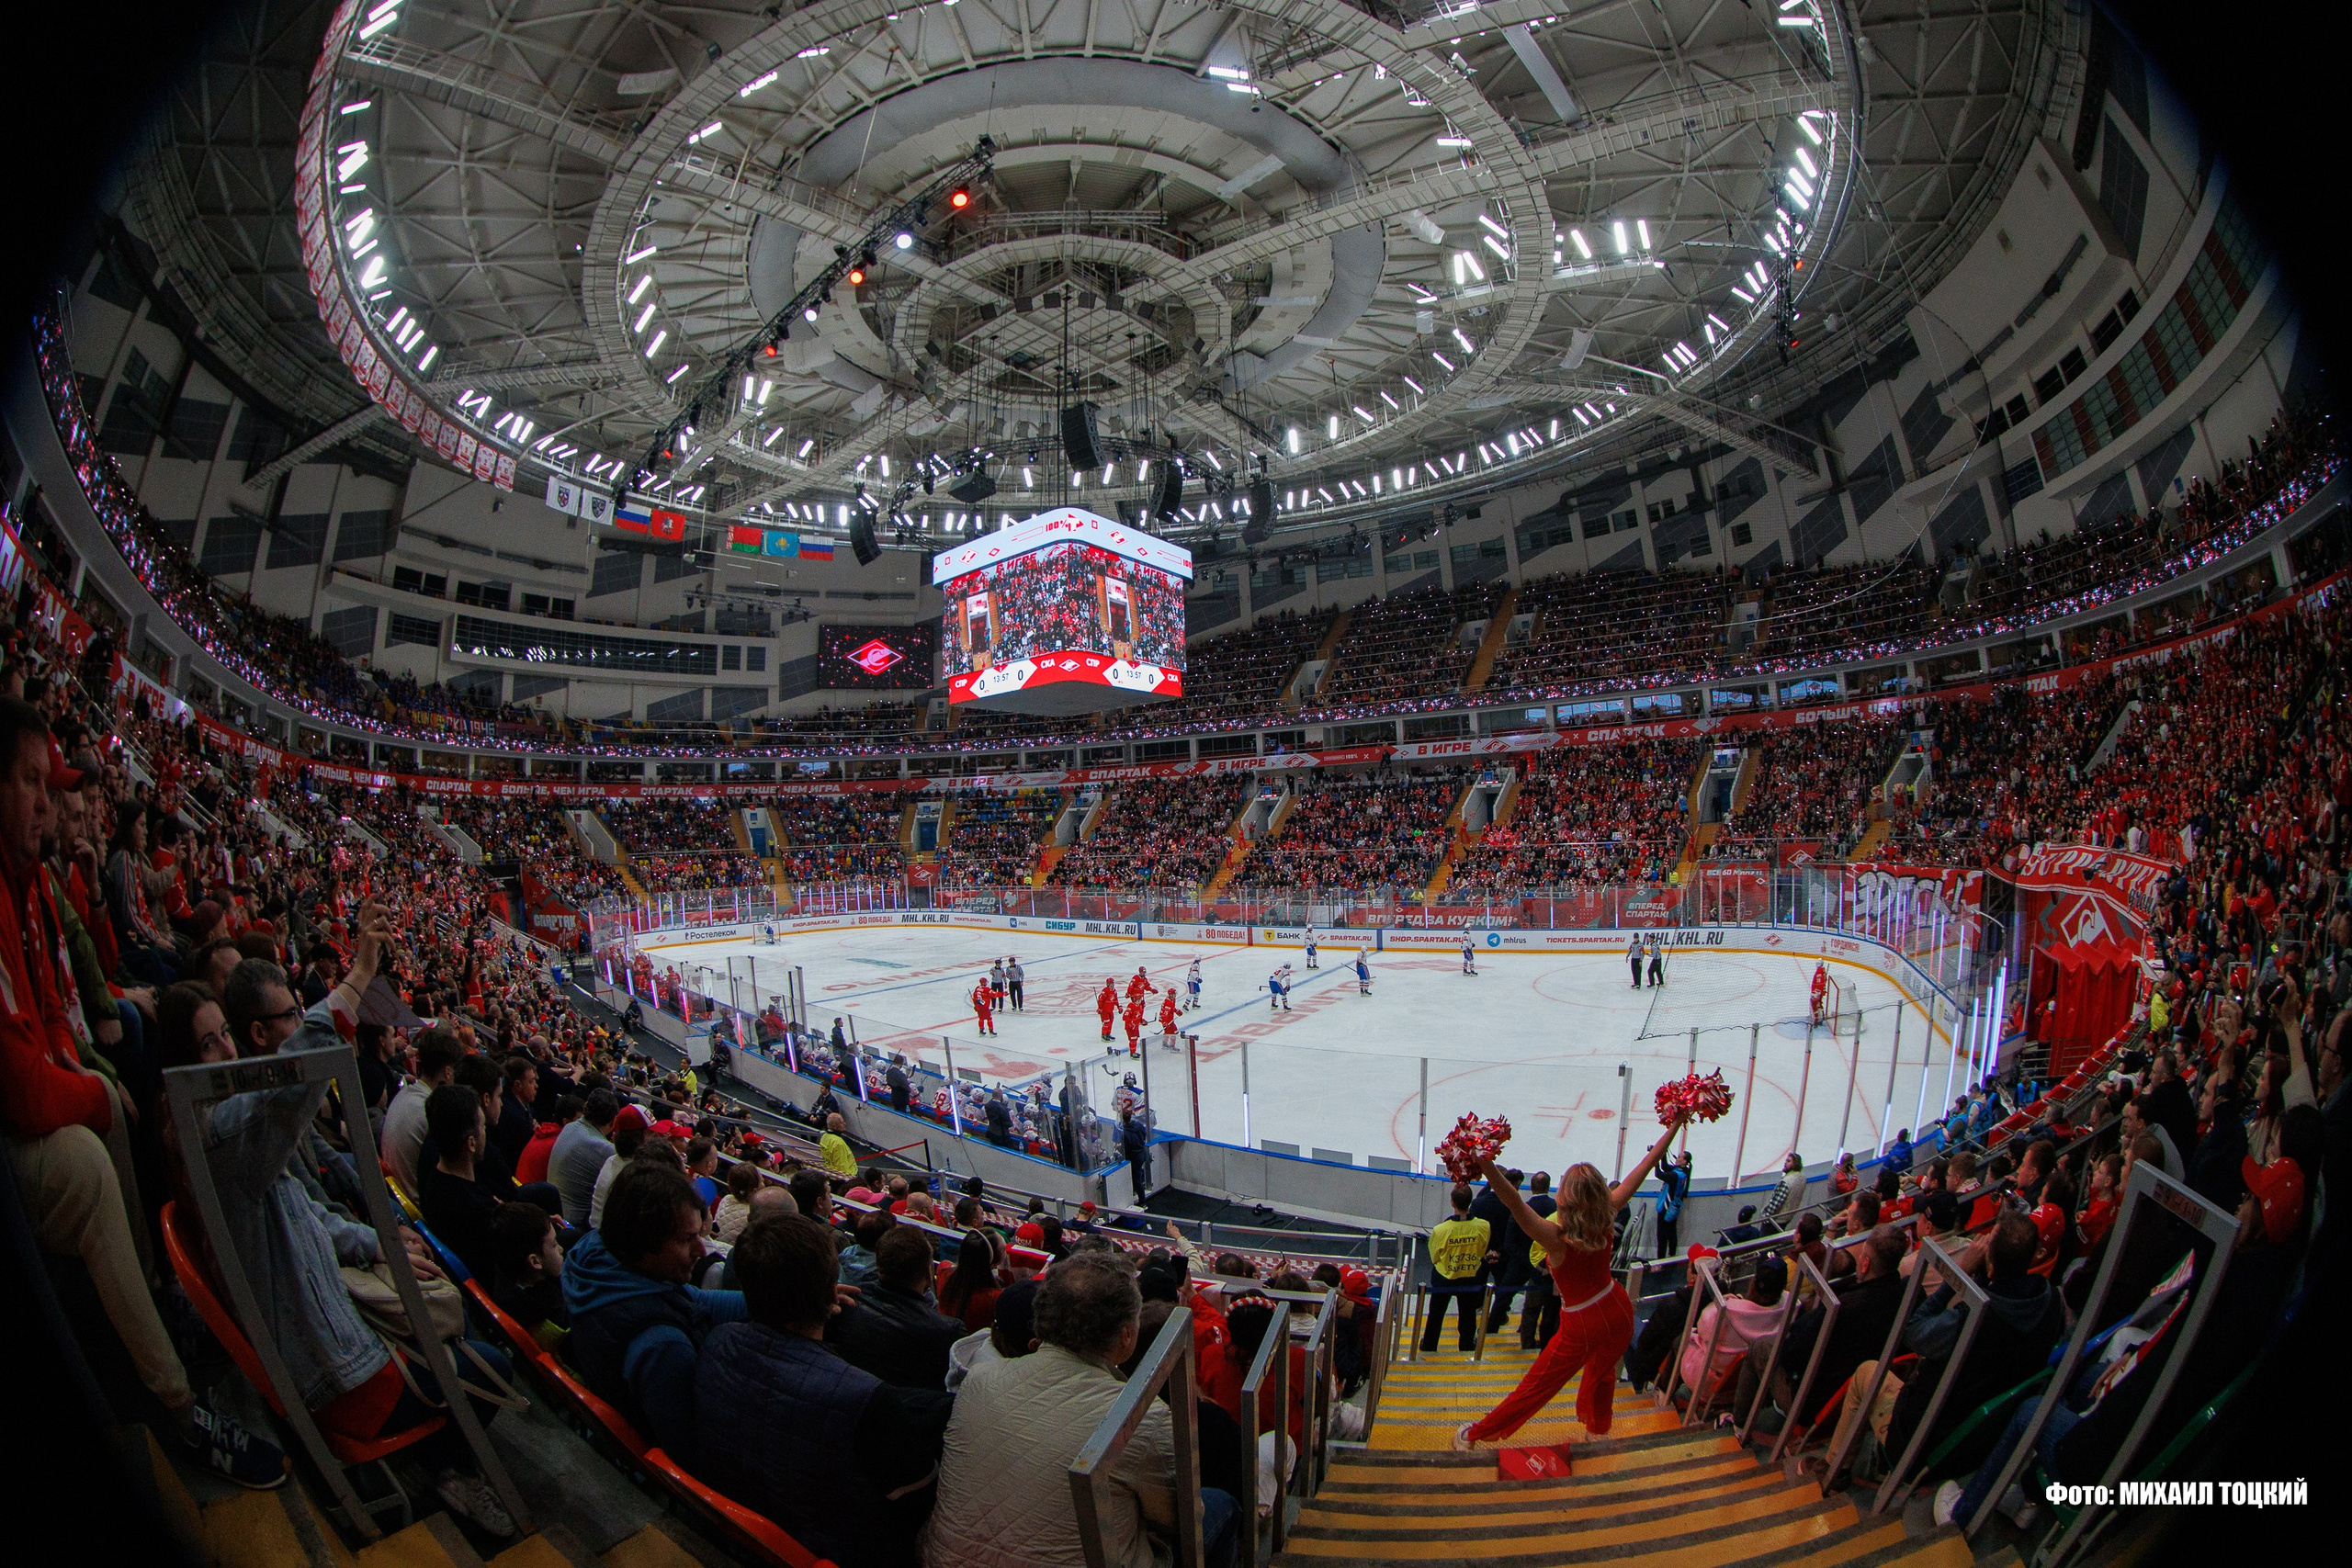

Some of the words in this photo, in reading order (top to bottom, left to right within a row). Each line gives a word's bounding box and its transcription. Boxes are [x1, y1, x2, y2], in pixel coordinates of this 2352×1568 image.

[1795, 706, 1864, 724] БОЛЬШЕ,
[1868, 700, 1899, 715] ЧЕМ
[469, 720, 495, 735] 1946
[1587, 725, 1666, 741] СПАРТАК
[1417, 745, 1428, 755] В
[1431, 741, 1472, 754] ИГРЕ
[243, 739, 282, 768] СПАРТАК
[1216, 761, 1227, 771] В
[1231, 758, 1267, 770] ИГРЕ
[1089, 766, 1151, 780] СПАРТАК
[354, 771, 371, 785] ЧЕМ
[373, 774, 397, 787] ИГРА
[948, 778, 958, 786] В
[961, 776, 995, 786] ИГРЕ
[426, 780, 472, 793] СПАРТАК
[553, 786, 575, 795] ЧЕМ
[578, 786, 605, 795] ИГРА
[640, 787, 693, 795] СПАРТАК
[784, 784, 808, 793] ЧЕМ
[810, 784, 841, 793] ИГРА
[901, 914, 949, 923] MHL.KHL.RU
[1625, 910, 1669, 919] СПАРТАК!
[792, 919, 840, 928] SHOP.SPARTAK.RU
[858, 916, 867, 925] 80
[868, 916, 893, 924] ПОБЕДА!
[1046, 920, 1076, 931] СИБУР
[1448, 916, 1514, 928] КУБКОМ!
[1085, 922, 1136, 935] MHL.KHL.RU
[690, 930, 737, 940] Ростелеком
[1205, 929, 1216, 939] 80
[1216, 931, 1246, 940] ПОБЕДА!
[1389, 935, 1464, 943] SHOP.SPARTAK.RU
[1643, 931, 1724, 945] MHL.KHL.RU
[1504, 936, 1526, 944] mhlrus
[1449, 1236, 1476, 1245] SAFETY
[1449, 1253, 1476, 1263] K3736
[1447, 1263, 1476, 1273] SAFETY
